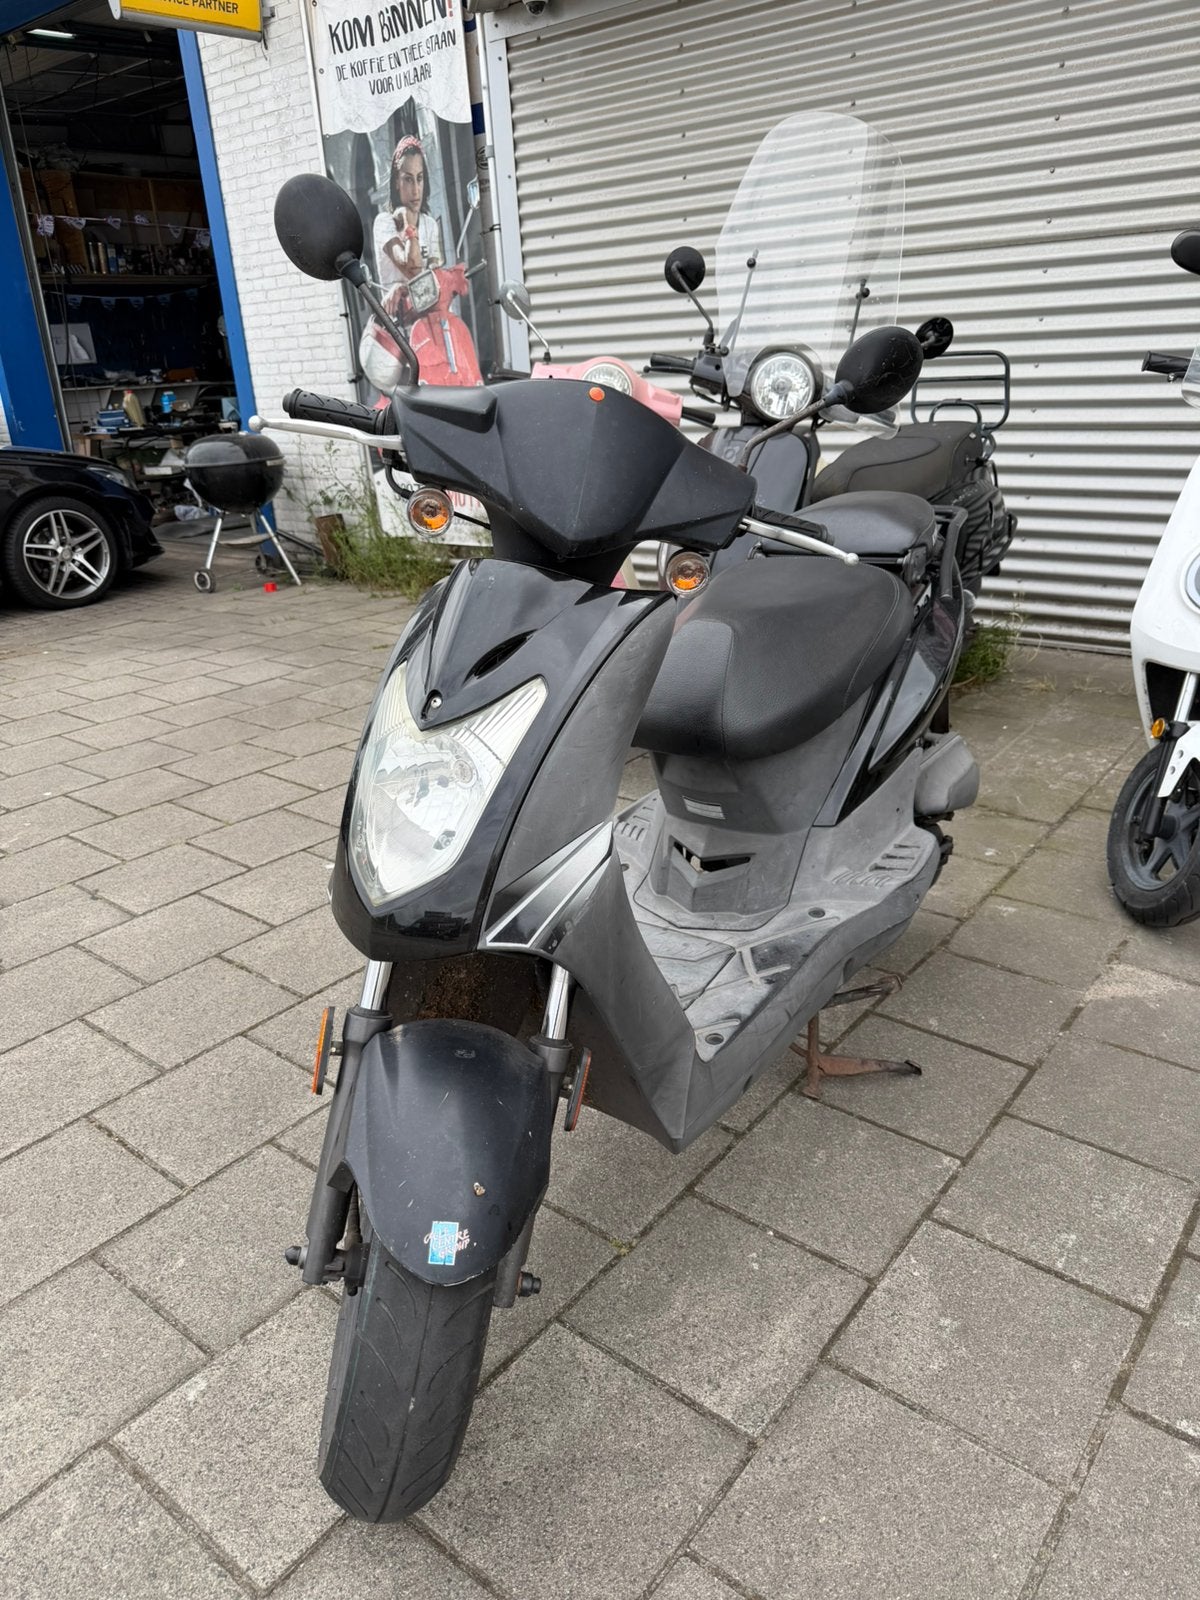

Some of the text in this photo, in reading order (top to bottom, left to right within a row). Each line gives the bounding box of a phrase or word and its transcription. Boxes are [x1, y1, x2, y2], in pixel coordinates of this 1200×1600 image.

[192, 0, 239, 14] PARTNER
[328, 14, 375, 55] KOM
[335, 64, 349, 82] DE
[388, 51, 401, 70] EN
[400, 41, 425, 64] THEE
[425, 29, 456, 55] STAAN
[368, 76, 394, 95] VOOR
[395, 73, 402, 90] U
